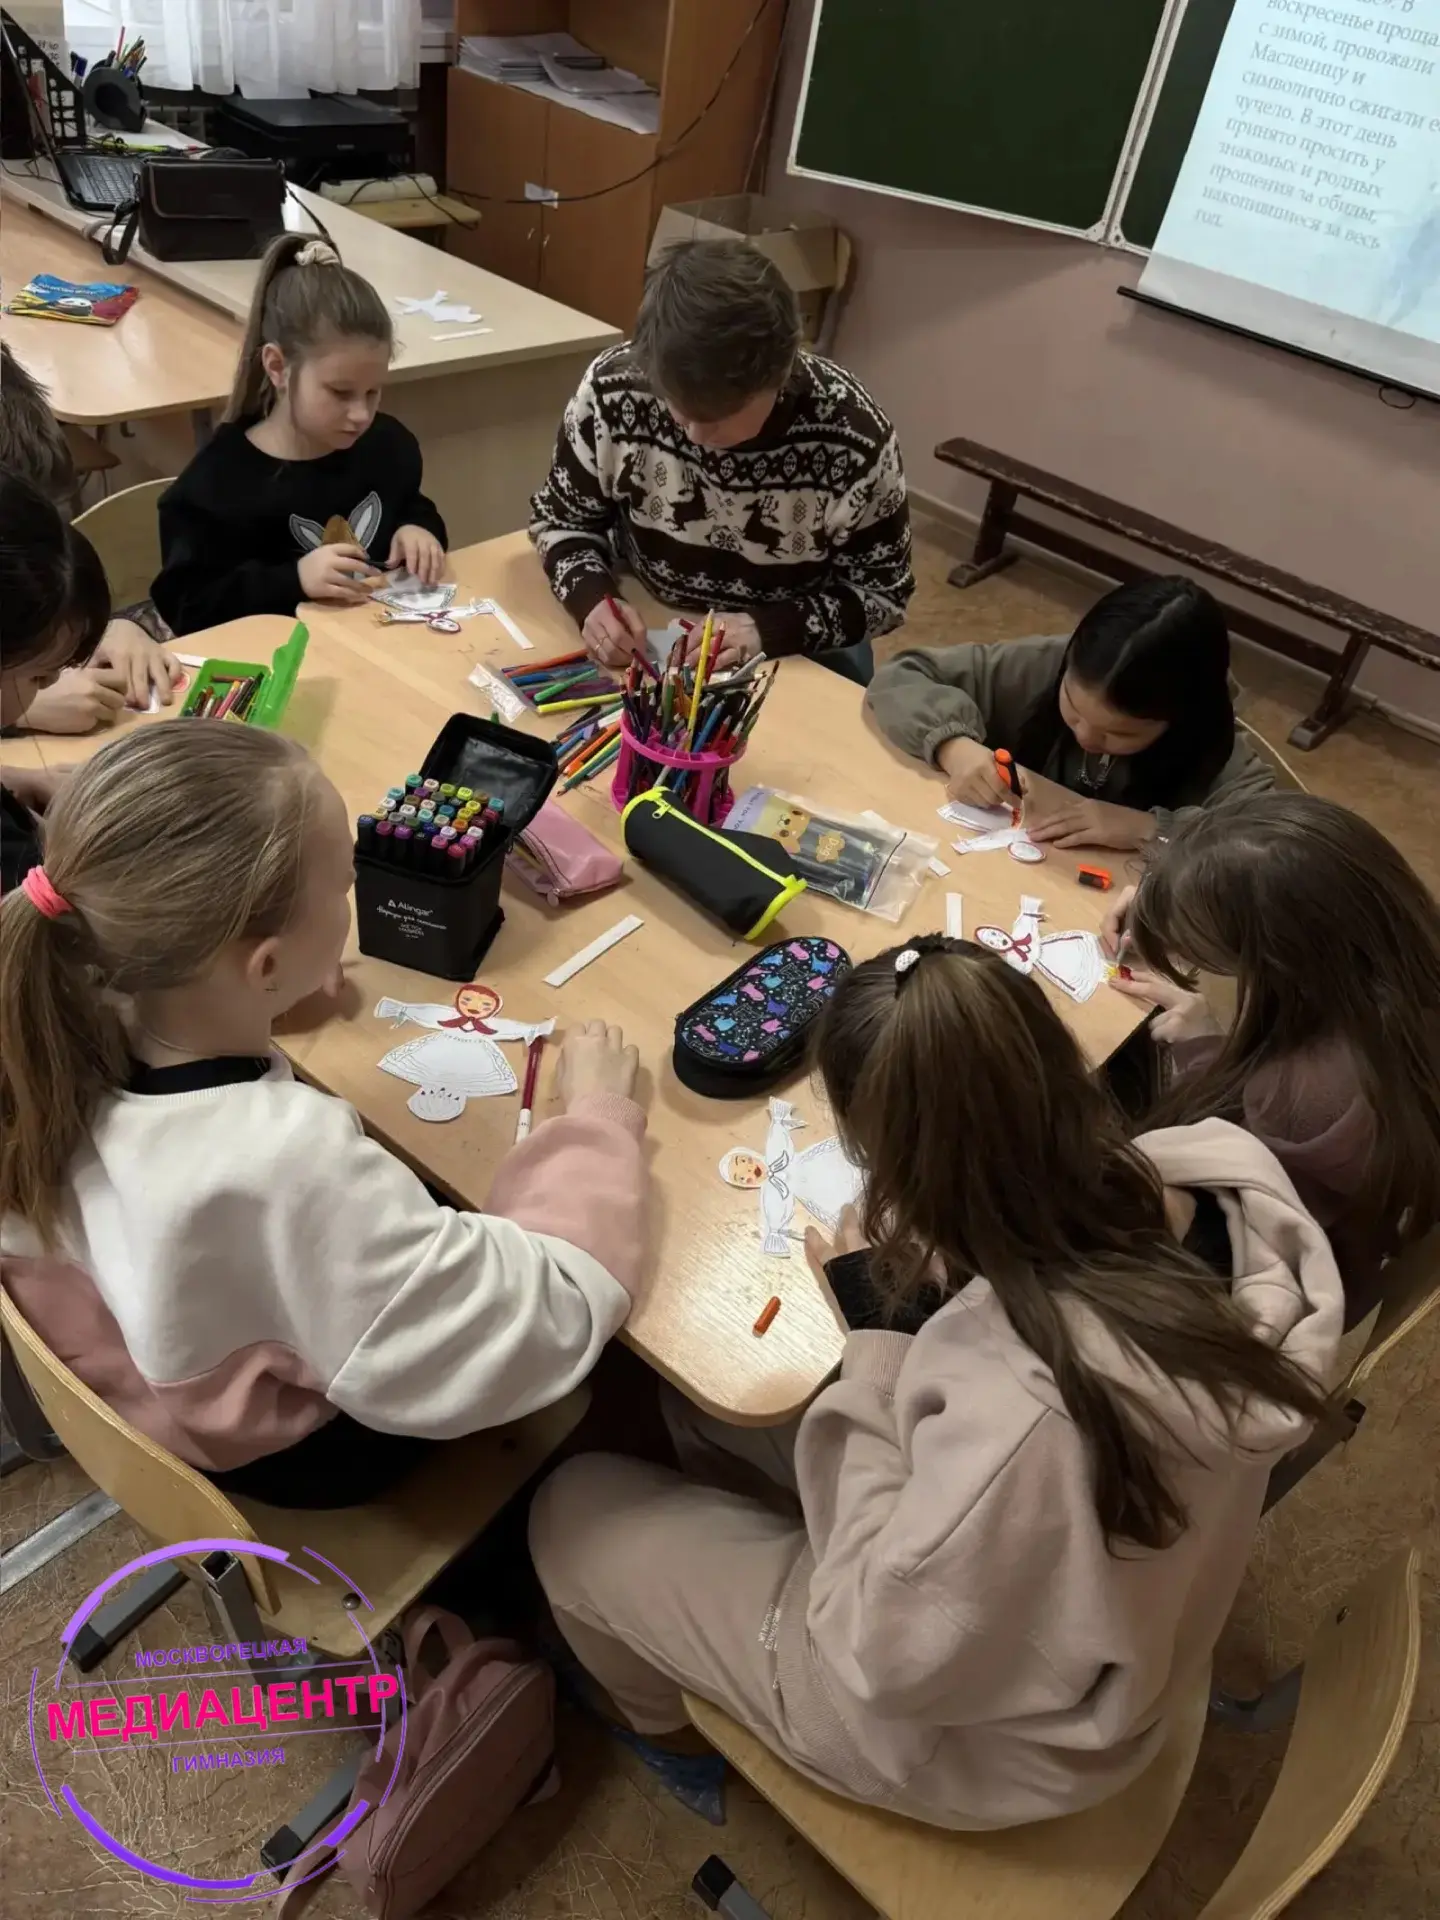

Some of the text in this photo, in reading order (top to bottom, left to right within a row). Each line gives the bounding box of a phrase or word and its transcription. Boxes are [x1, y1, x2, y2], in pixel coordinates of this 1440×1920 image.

[1259, 22, 1436, 75] с зимой, провожали
[1267, 0, 1440, 47] воскресенье проща
[1250, 41, 1367, 85] Масленицу и
[1236, 94, 1398, 149] чучело. В этот день
[1242, 70, 1440, 133] символично сжигали е
[1218, 141, 1384, 198] знакомых и родных
[1225, 117, 1387, 177] принято просить у
[1202, 185, 1381, 250] накопившиеся за весь
[1209, 163, 1378, 225] прощения за обиды,
